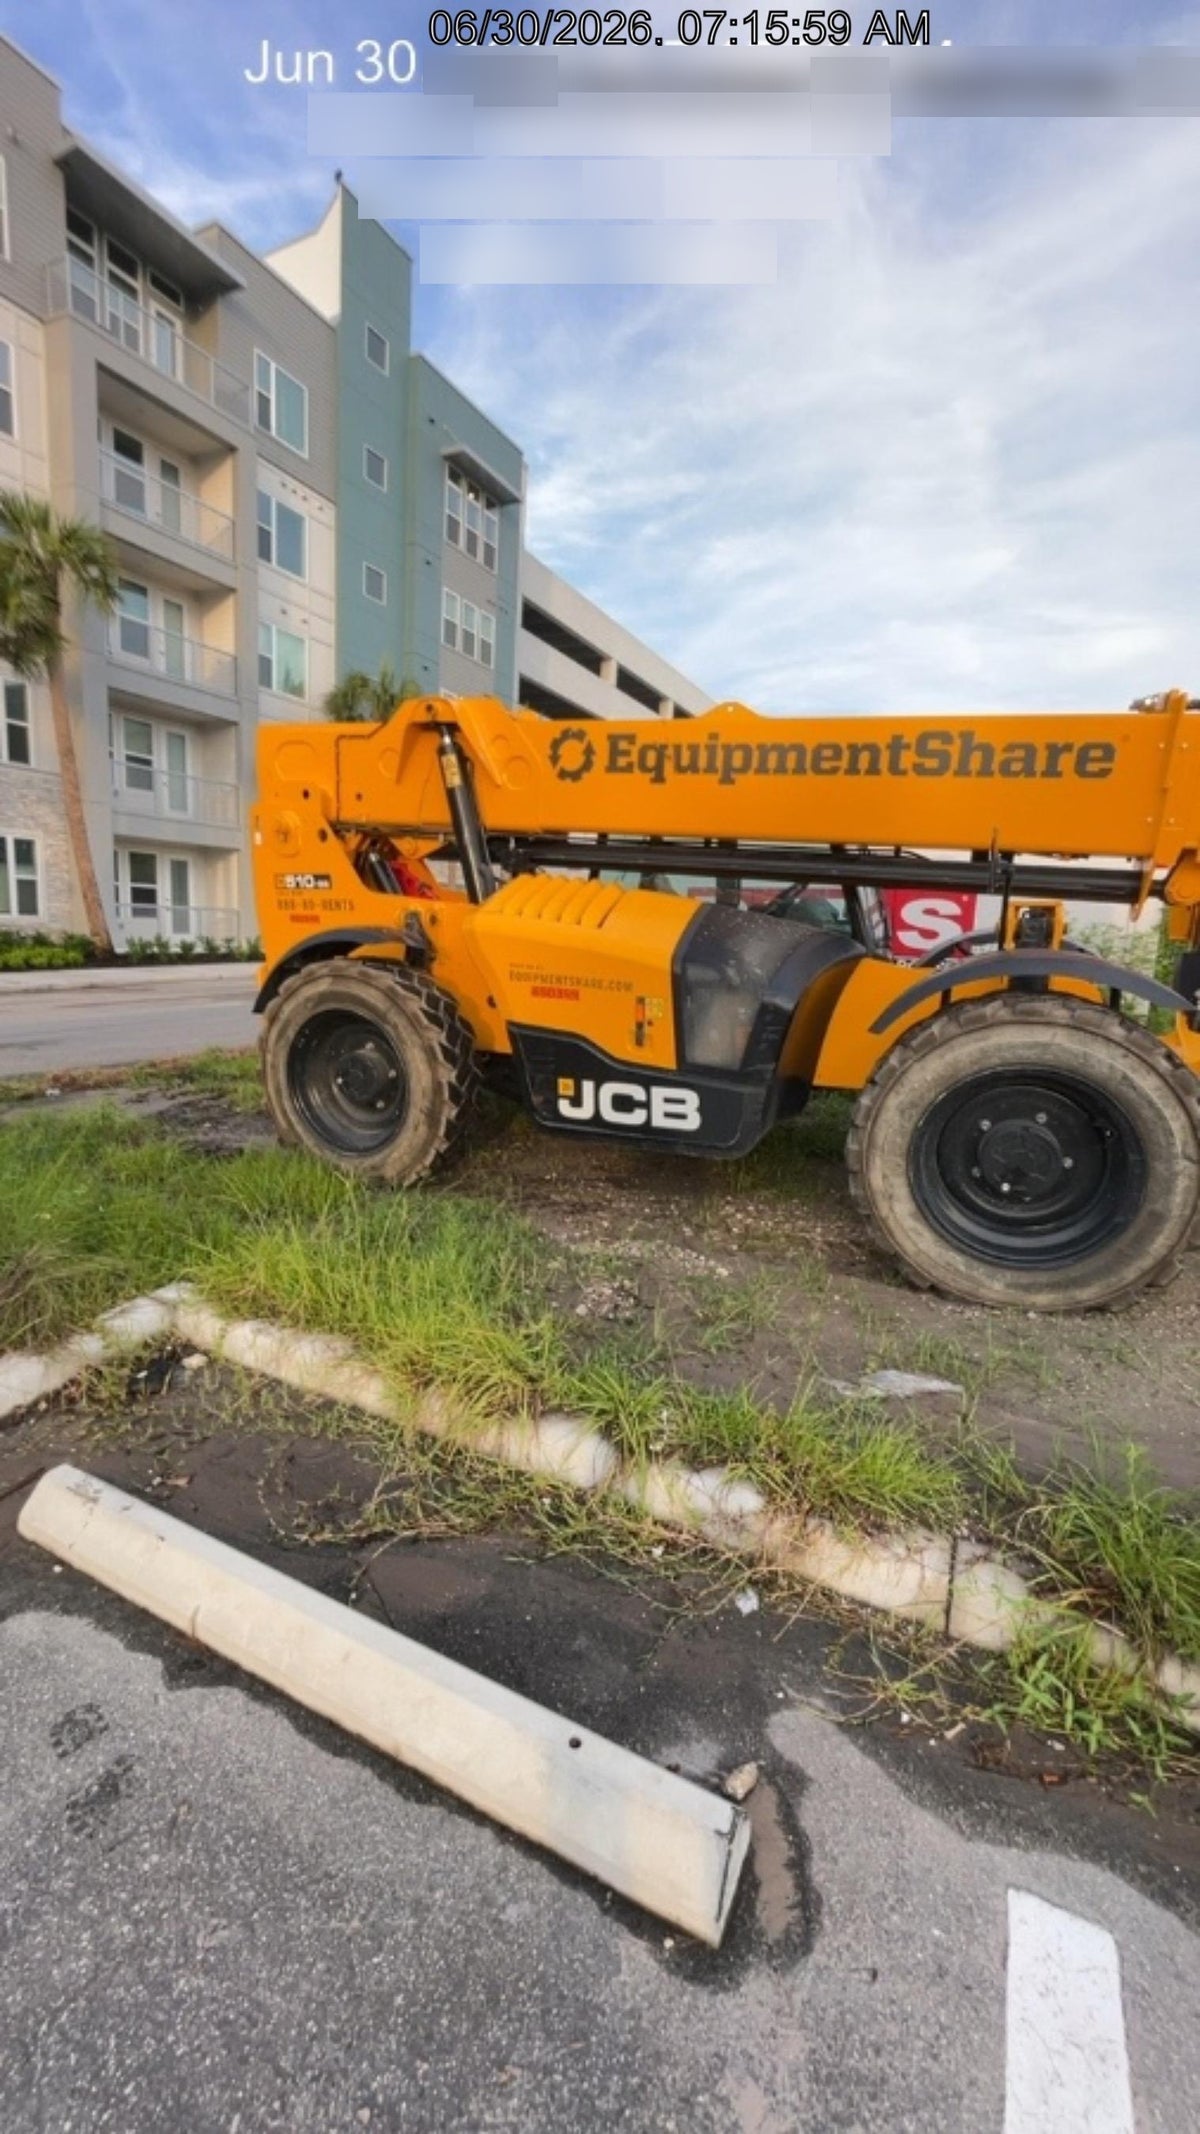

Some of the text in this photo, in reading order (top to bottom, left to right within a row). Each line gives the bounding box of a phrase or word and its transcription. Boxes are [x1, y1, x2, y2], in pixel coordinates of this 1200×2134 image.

[606, 730, 1116, 785] EquipmentShare
[895, 897, 964, 952] S
[557, 1076, 702, 1132] JCB
